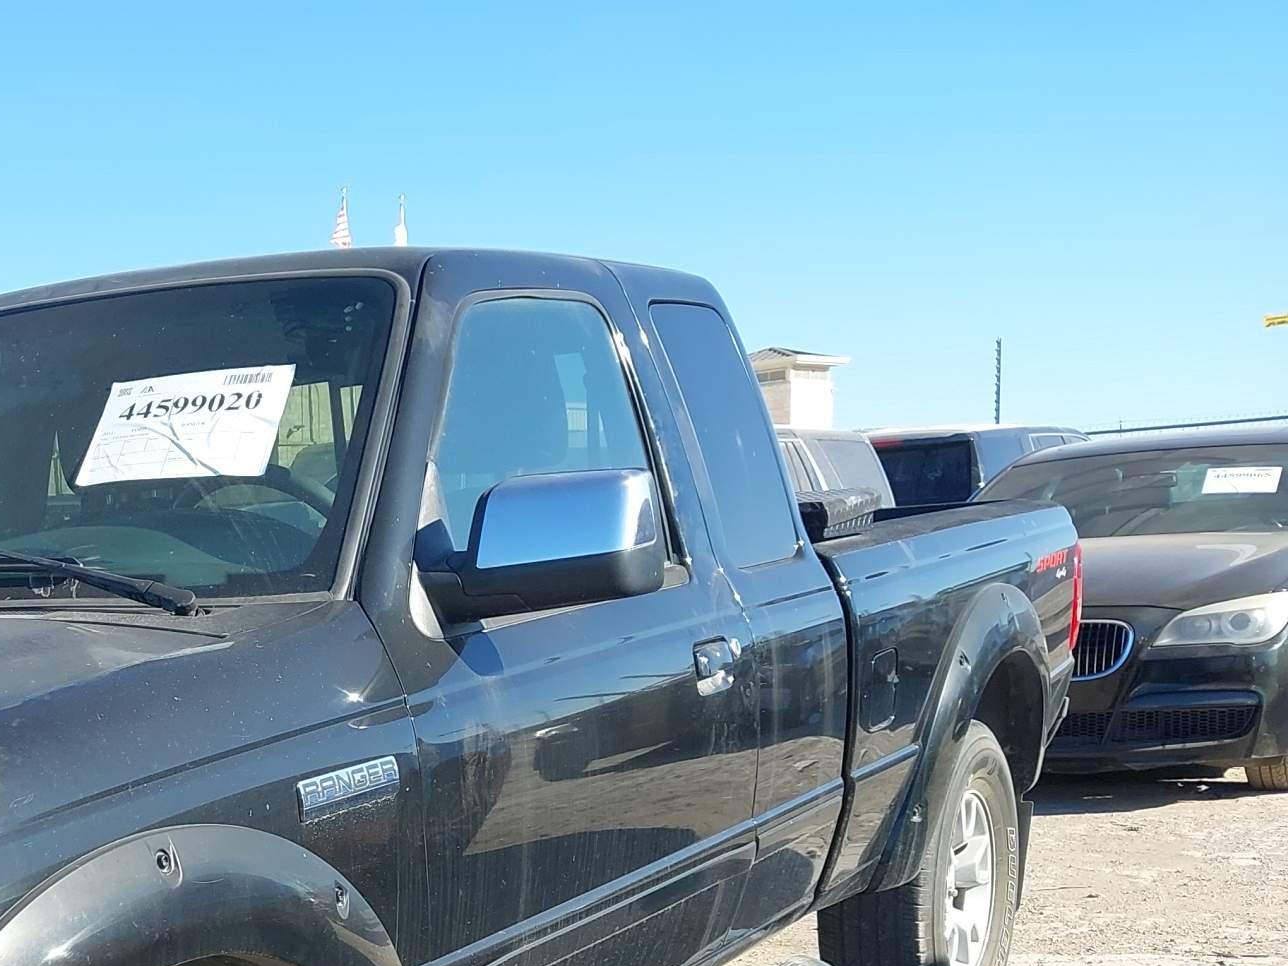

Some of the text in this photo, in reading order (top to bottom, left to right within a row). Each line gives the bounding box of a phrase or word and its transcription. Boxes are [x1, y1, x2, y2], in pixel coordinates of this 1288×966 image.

[119, 390, 263, 420] 44599020
[1036, 549, 1069, 573] SPORT
[302, 760, 397, 806] RANGER
